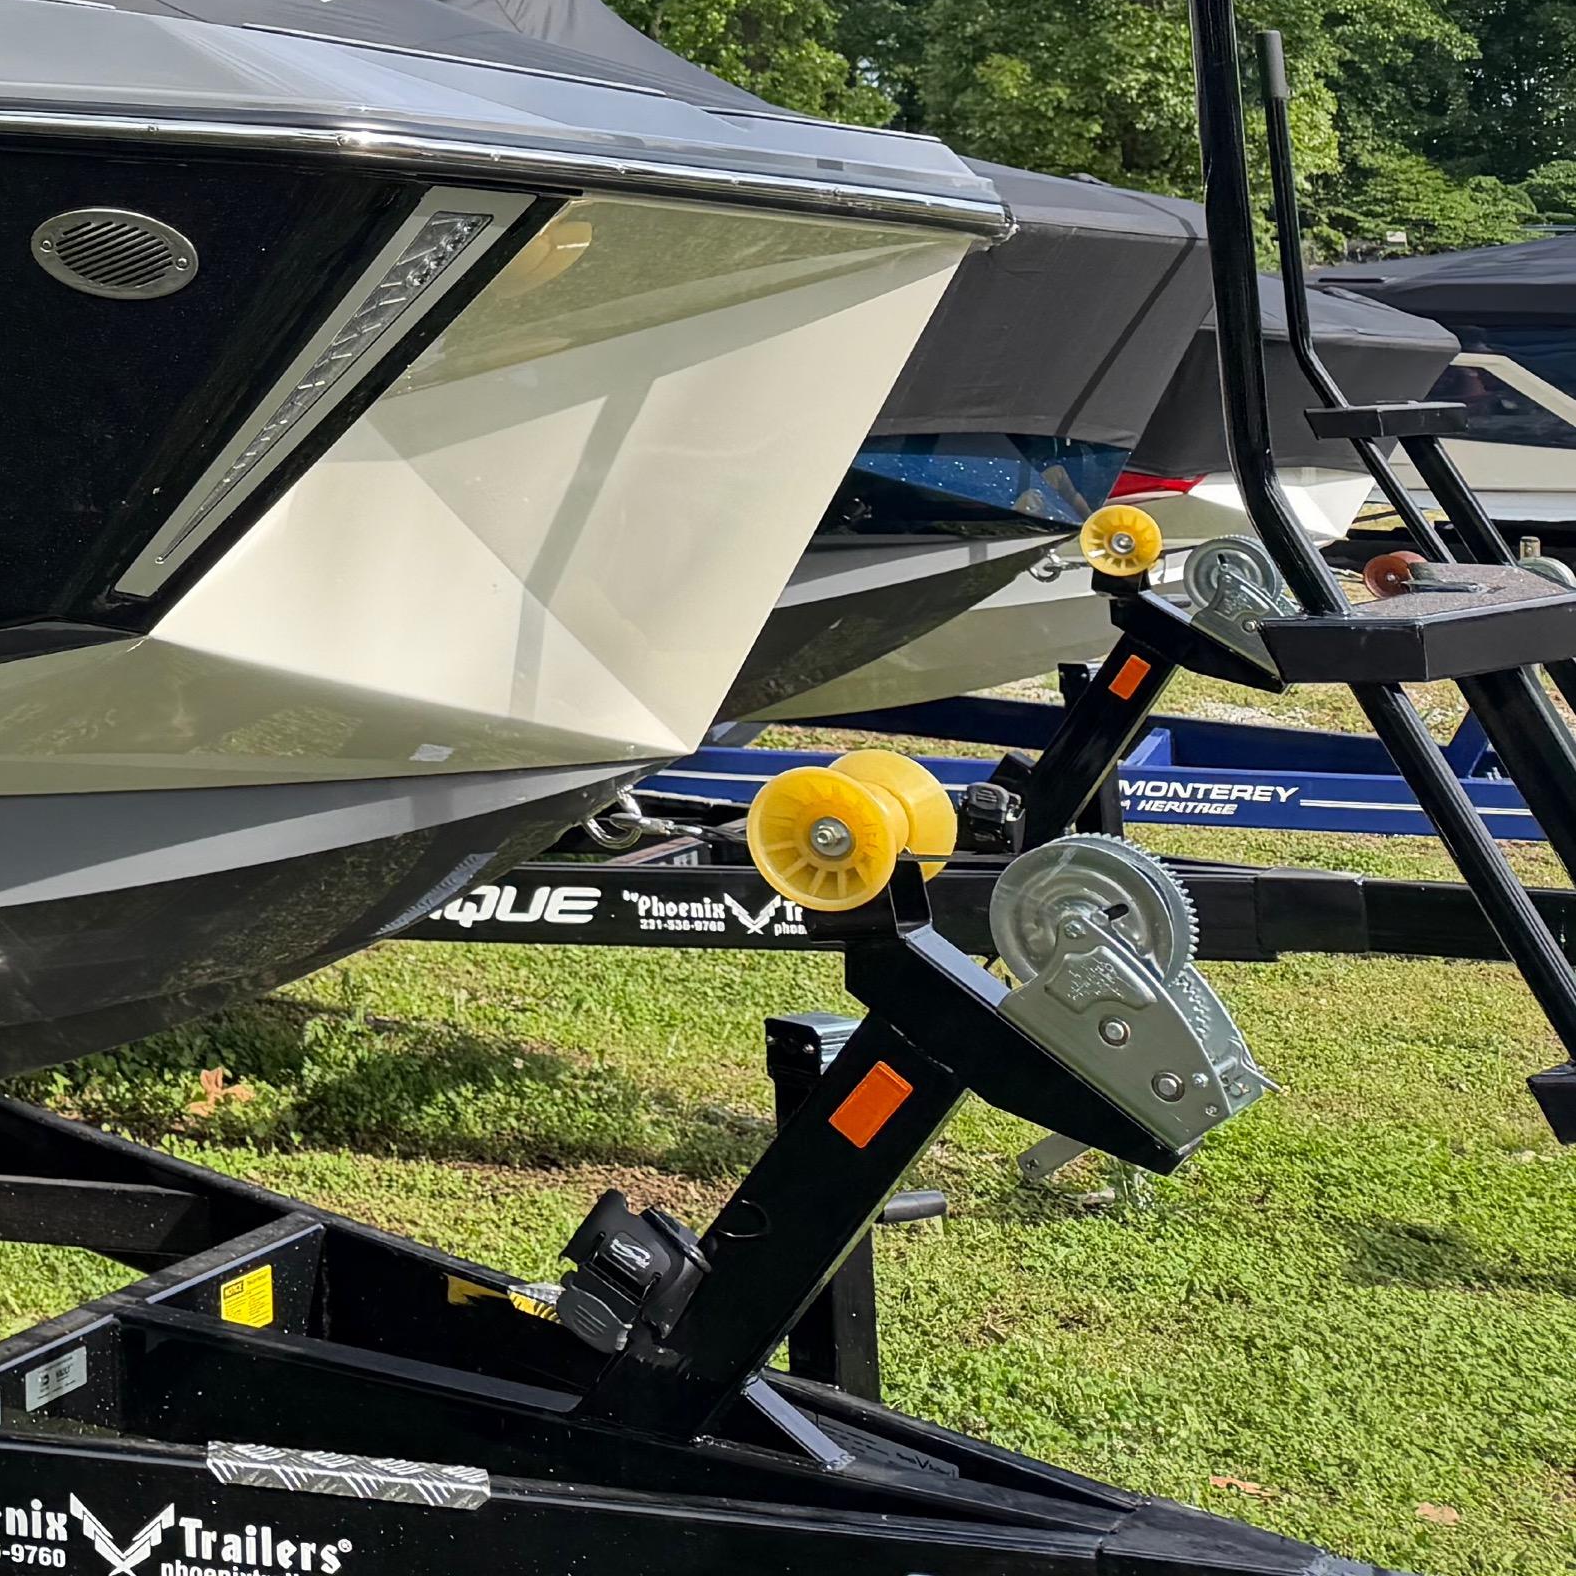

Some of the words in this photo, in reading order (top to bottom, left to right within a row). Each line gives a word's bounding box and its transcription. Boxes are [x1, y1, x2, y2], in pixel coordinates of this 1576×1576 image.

[1118, 779, 1299, 803] MONTEREY
[1137, 799, 1238, 815] HERITAGE
[638, 895, 725, 919] Phoenix
